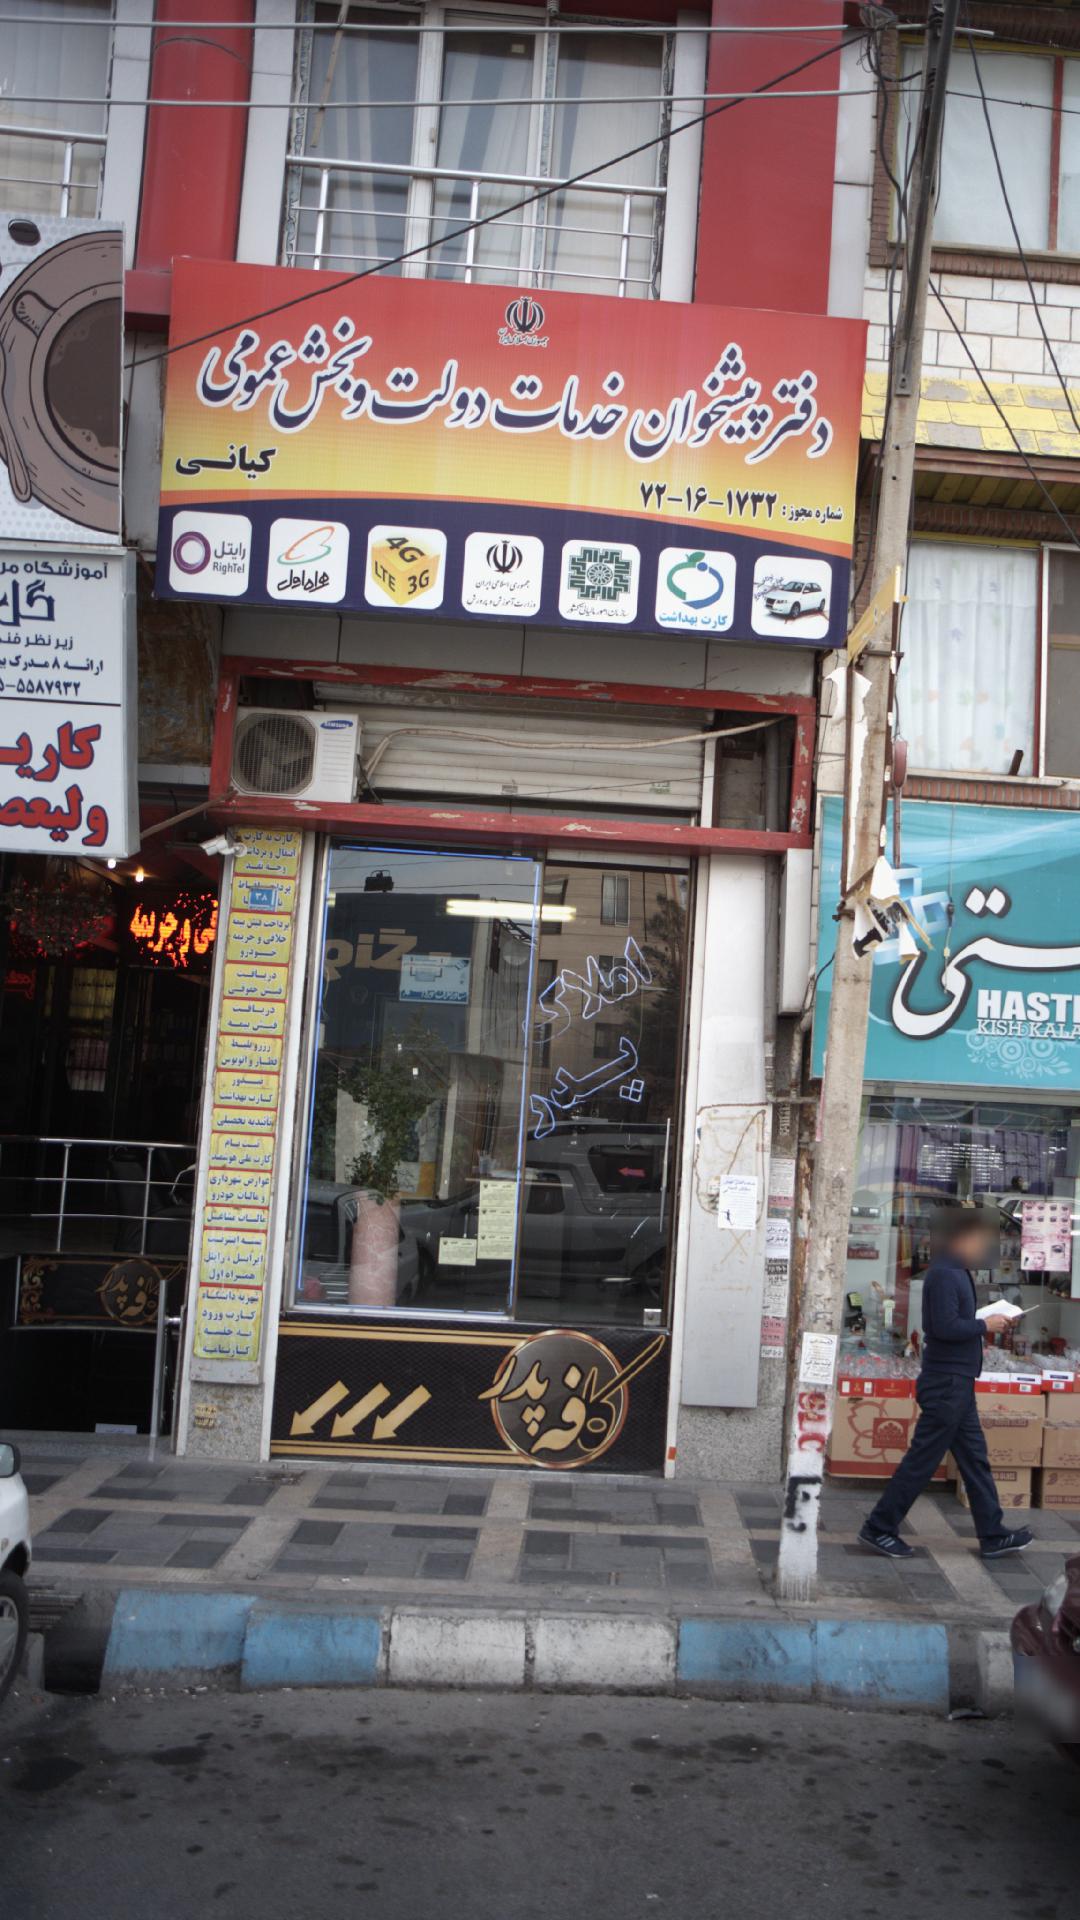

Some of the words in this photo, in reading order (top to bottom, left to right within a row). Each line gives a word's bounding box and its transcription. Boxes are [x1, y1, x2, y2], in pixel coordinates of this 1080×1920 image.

[197, 330, 296, 409] عمومی
[270, 317, 371, 432] بخش
[368, 360, 489, 428] دولت
[491, 371, 628, 439] خدمات
[626, 344, 771, 462] پیشخوان
[746, 371, 832, 464] دفتر
[175, 445, 277, 480] کیانی
[814, 505, 843, 524] شماره
[214, 541, 246, 560] رایتل
[386, 537, 425, 563] 4G
[23, 559, 108, 580] آموزشگاه
[277, 569, 305, 591] اول
[303, 570, 330, 593] همراه
[374, 560, 396, 593] LTE
[407, 569, 430, 595] 3G
[475, 580, 492, 590] ایران
[491, 579, 509, 590] اسلامی
[509, 579, 530, 591] جمهوری
[658, 611, 698, 627] بهداشت
[700, 614, 727, 629] کارت
[25, 633, 51, 648] نظر
[54, 635, 73, 650] زیر
[9, 655, 49, 671] مدرک
[243, 832, 263, 845] کارت
[274, 834, 293, 845] کارت
[263, 918, 290, 932] پرداخت
[232, 933, 255, 944] جریمه
[263, 933, 287, 945] خلافی
[240, 948, 277, 959] خودرو
[236, 969, 277, 983] دریافت
[228, 982, 258, 996] حقوقی
[232, 1004, 275, 1016] دریافت
[976, 1018, 1023, 1037] KISH
[221, 1056, 248, 1066] اتوبوس
[255, 1056, 278, 1067] قطار
[219, 1091, 247, 1103] بهداشت
[248, 1093, 273, 1104] کارت
[216, 1115, 245, 1127] تحصیلی
[253, 1155, 271, 1167] کارت
[209, 1174, 242, 1186] شهرداری
[243, 1176, 270, 1188] عوارض
[211, 1190, 234, 1201] خودرو
[237, 1191, 259, 1200] مالیات
[237, 1213, 266, 1223] مالیات
[208, 1268, 225, 1280] اول
[225, 1271, 256, 1282] همراه
[201, 1289, 236, 1302] دانشگاه
[237, 1292, 259, 1305] شهریه
[201, 1309, 224, 1321] ورود
[225, 1310, 256, 1322] کارت
[202, 1344, 251, 1358] کارنامه
